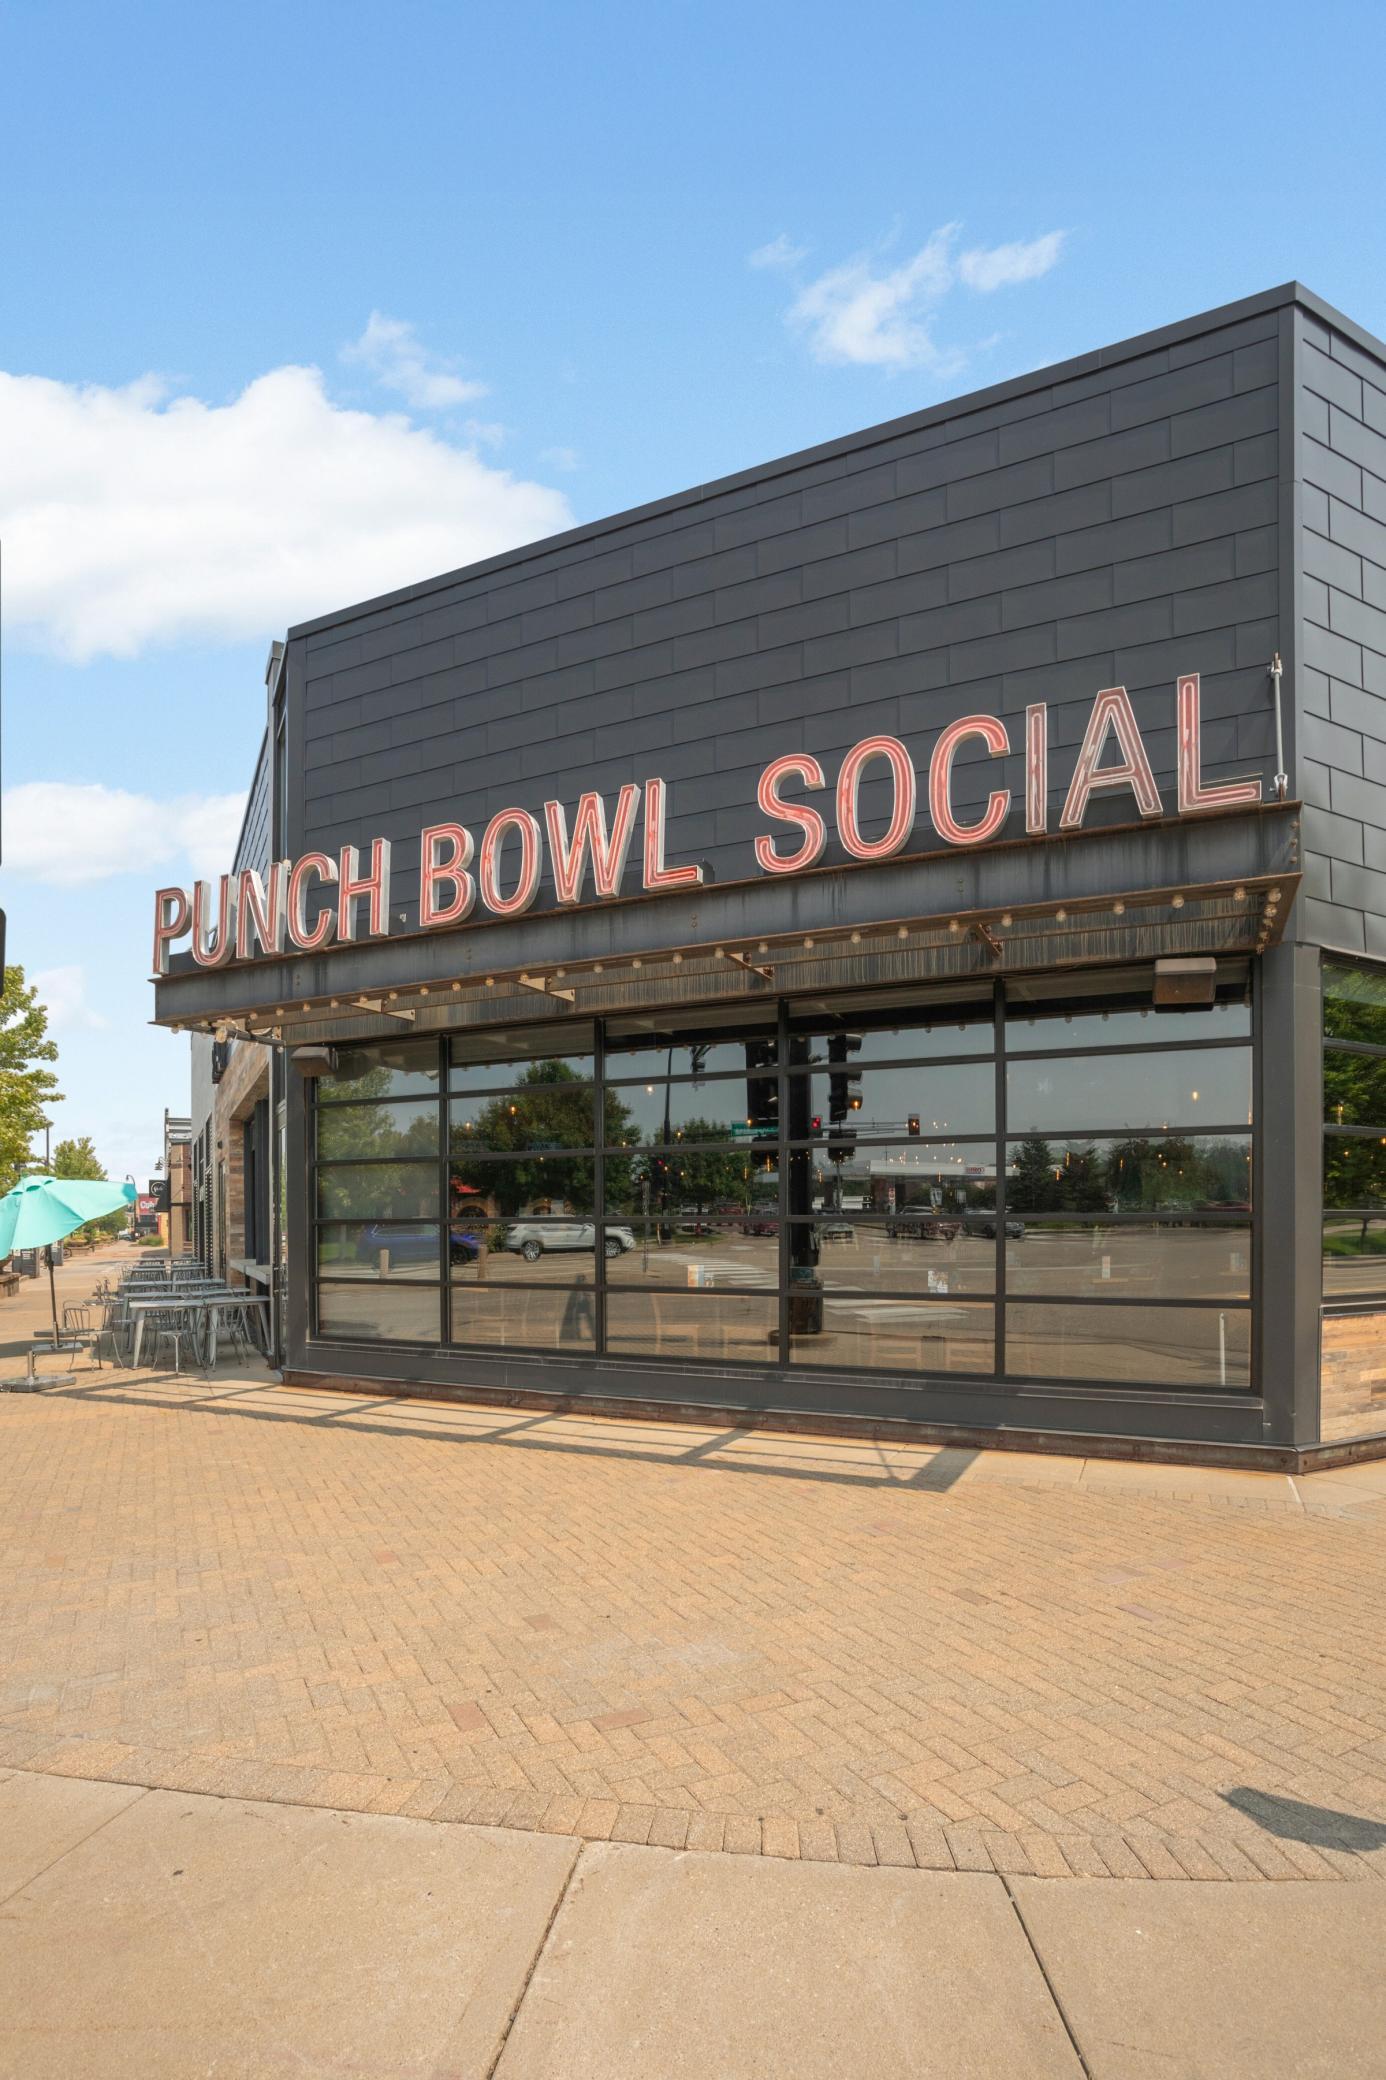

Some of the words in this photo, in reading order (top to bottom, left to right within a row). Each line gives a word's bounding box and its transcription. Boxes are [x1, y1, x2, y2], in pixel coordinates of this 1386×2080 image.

[153, 837, 391, 975] PUNCH
[419, 777, 703, 927] BOWL
[753, 673, 1262, 873] SOCIAL
